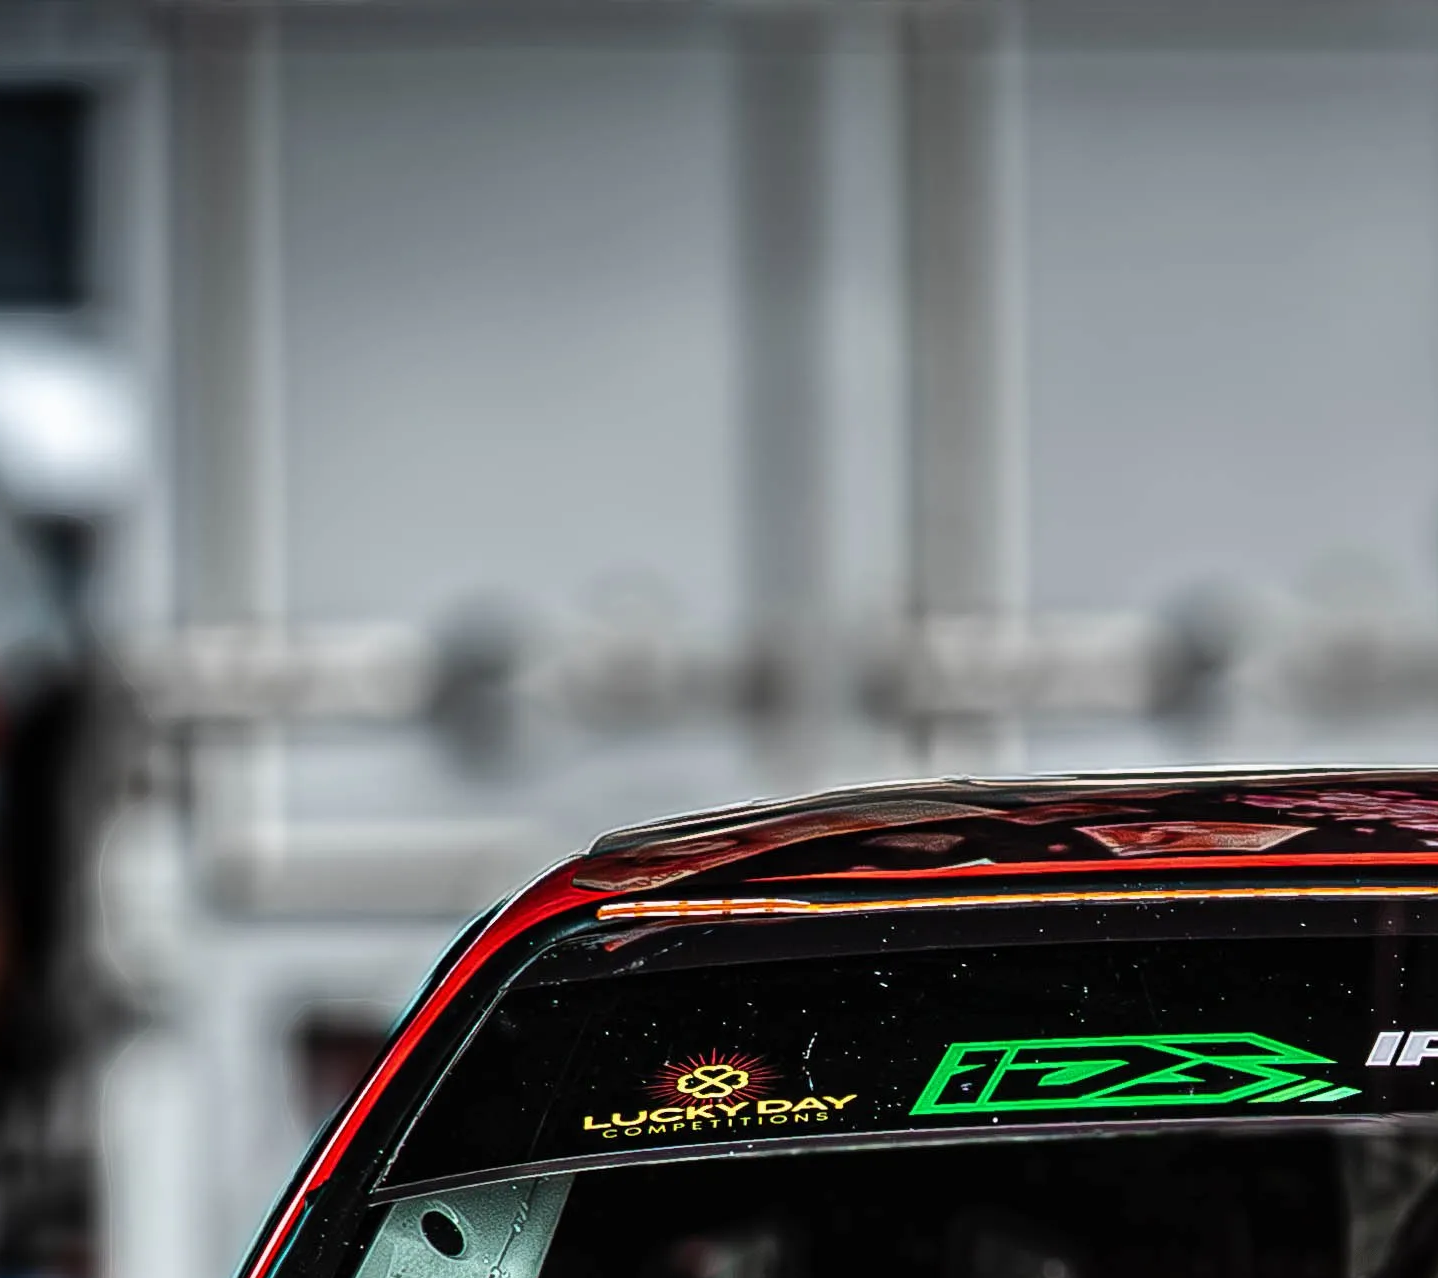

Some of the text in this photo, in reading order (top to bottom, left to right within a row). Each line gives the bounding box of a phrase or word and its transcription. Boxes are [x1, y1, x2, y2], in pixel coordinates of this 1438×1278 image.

[583, 1094, 857, 1130] LUCKY DAY
[602, 1111, 829, 1139] COMPETITIONS
